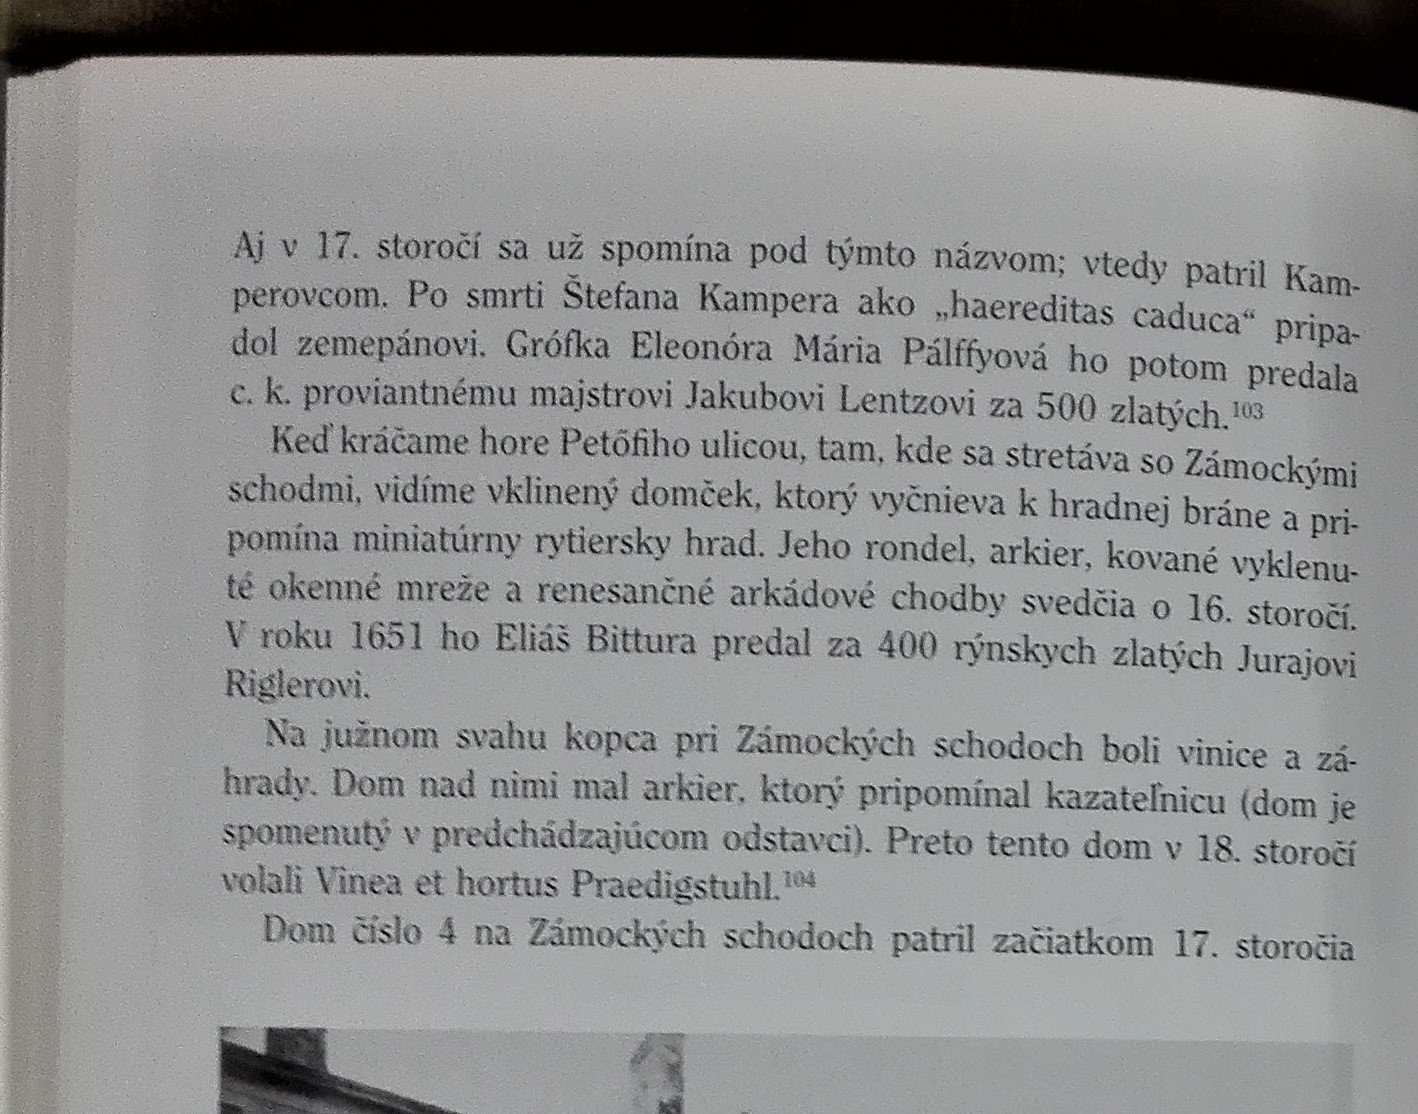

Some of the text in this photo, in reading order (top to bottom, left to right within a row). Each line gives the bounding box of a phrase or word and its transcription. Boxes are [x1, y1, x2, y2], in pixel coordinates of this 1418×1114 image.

[233, 230, 1360, 298] Aj v 17. storočí sa už spomína pod týmto názvom; vtedy patril Kam-
[231, 326, 1359, 394] dol zemepánovi. Grófka Eleonóra Mária Pálffyová ho potom predala
[229, 384, 253, 406] c.
[265, 375, 291, 405] k.
[303, 376, 517, 412] proviantnému
[529, 378, 672, 413] majstrovi
[684, 379, 825, 412] Jakubovi
[838, 383, 976, 417] Lentzovi
[988, 397, 1024, 420] za
[1036, 391, 1097, 422] 500
[227, 522, 340, 558] pomína
[352, 523, 522, 560] miniatúrny
[535, 525, 672, 562] rytiersky
[685, 526, 765, 558] hrad.
[777, 529, 852, 560] Jeho
[865, 532, 976, 568] rondel,
[1106, 539, 1219, 575] kované
[1231, 548, 1359, 584] vyklenu-
[226, 570, 1357, 631] té okenné mreže a renesančné arkádové chodby svedčia o 16. storočí.
[224, 667, 370, 705] Riglerovi.
[223, 765, 318, 803] hrady.
[332, 767, 405, 798] Dom
[419, 768, 477, 799] nad
[490, 770, 559, 800] nimi
[572, 770, 629, 801] mal
[760, 773, 845, 811] ktorý
[858, 777, 1031, 813] pripomínal
[1045, 780, 1226, 815] kazateľnicu
[1240, 787, 1317, 821] (dom
[1327, 792, 1356, 825] je
[220, 863, 303, 895] volali
[315, 865, 403, 896] Vinea
[414, 869, 445, 897] et
[456, 866, 559, 898] hortus
